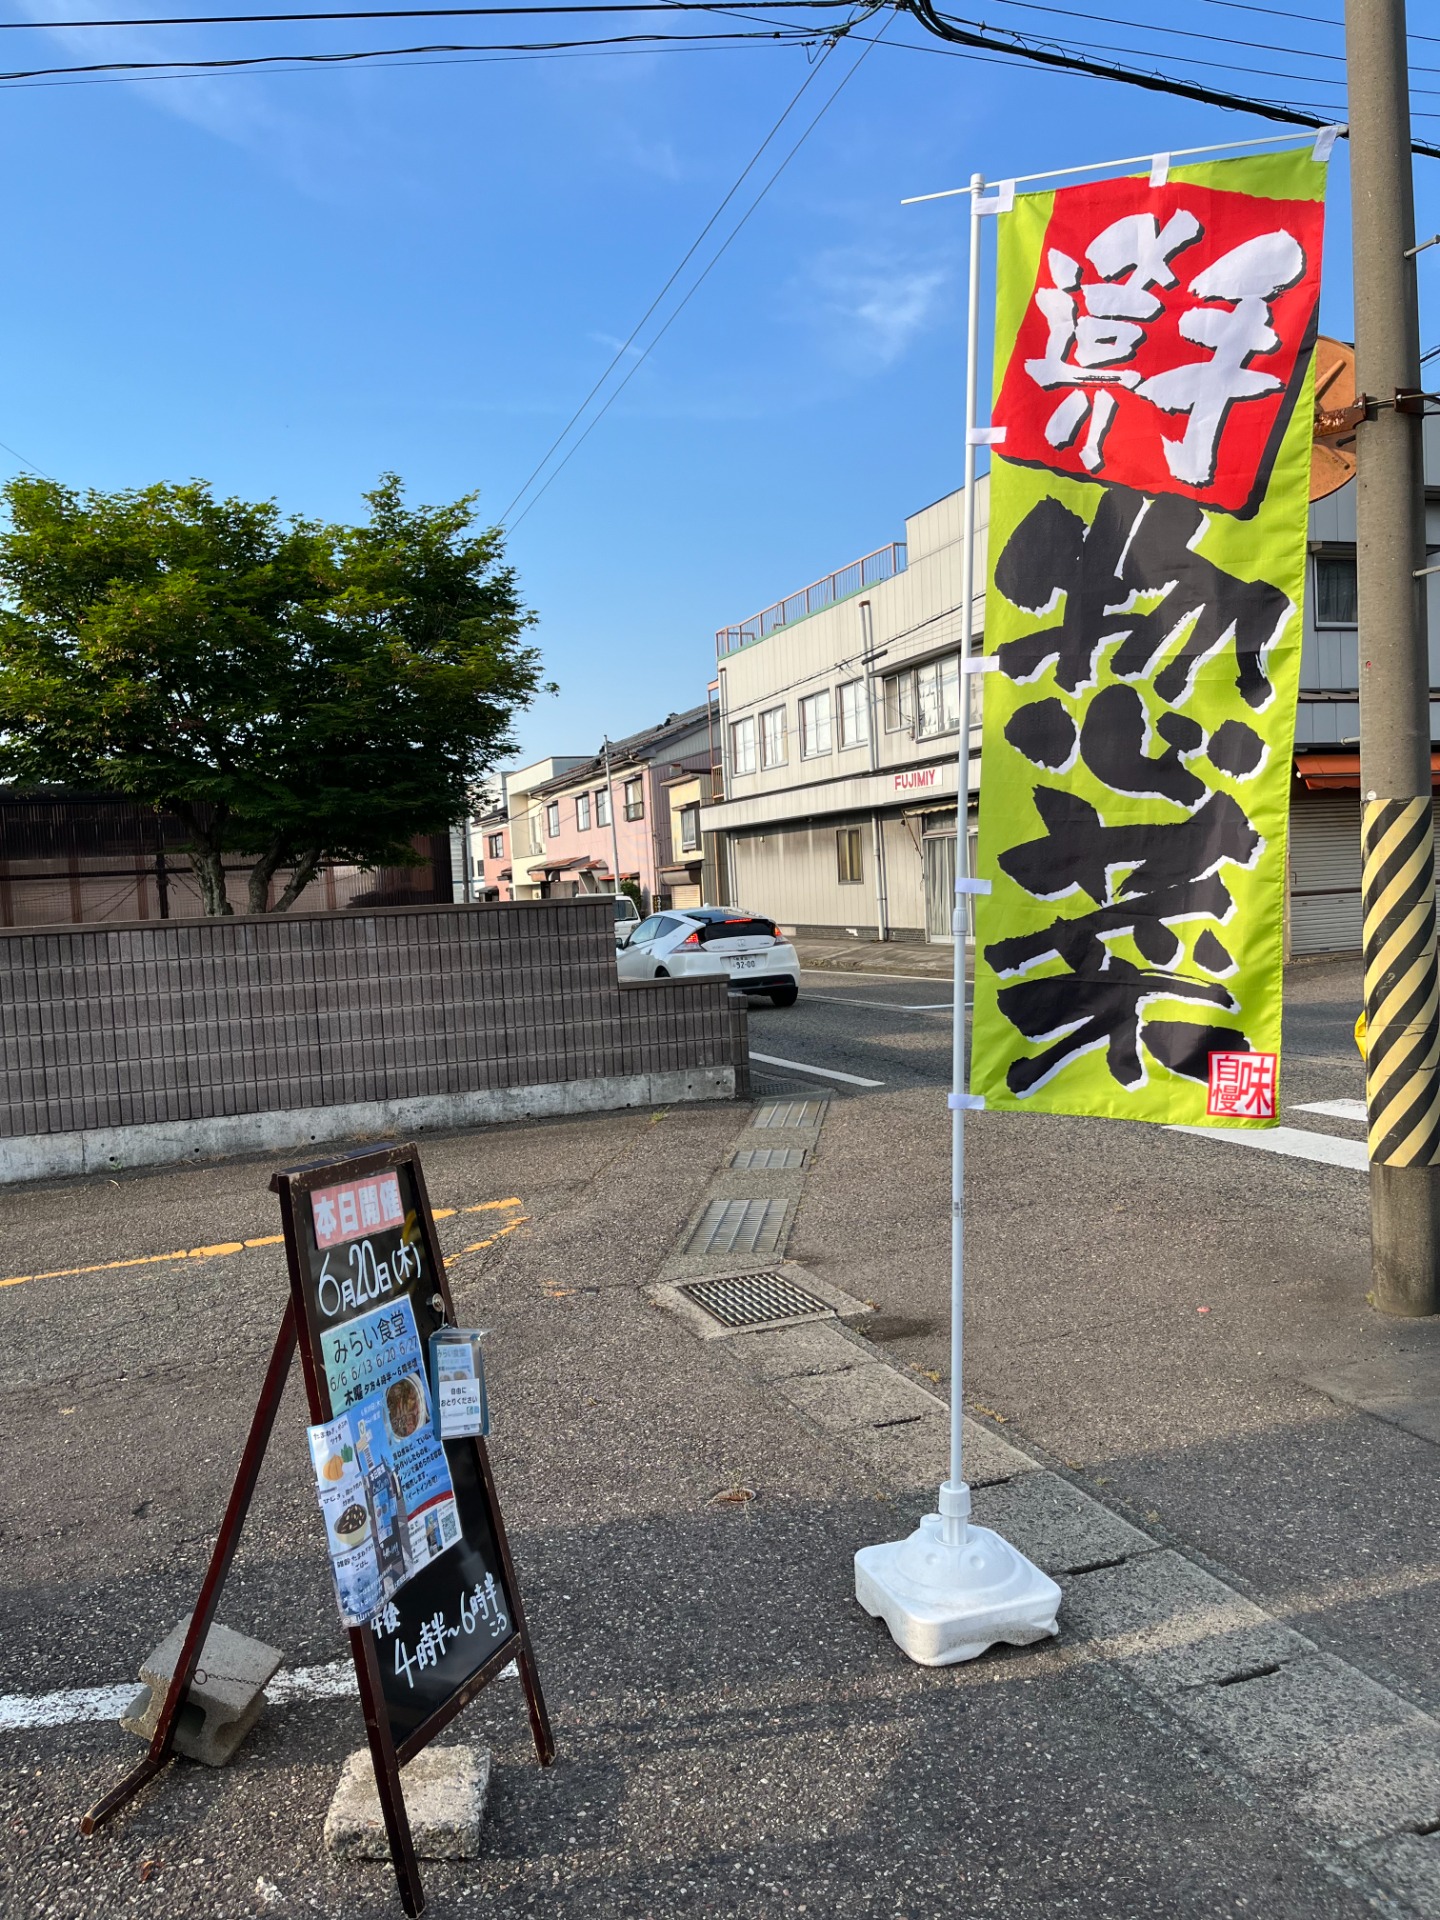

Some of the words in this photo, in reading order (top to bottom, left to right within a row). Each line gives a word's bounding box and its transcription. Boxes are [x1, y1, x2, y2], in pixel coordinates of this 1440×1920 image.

[894, 769, 936, 791] FUJIMIY
[983, 488, 1297, 1099] 惣菜
[313, 1178, 402, 1240] 本日開催
[333, 1312, 408, 1364] みらい食堂
[330, 1371, 348, 1392] 6/6
[351, 1359, 374, 1381] 6/13
[376, 1345, 397, 1367] 6/20
[343, 1383, 364, 1407] 木曜
[440, 1395, 478, 1408] おとりください
[450, 1386, 467, 1395] 自由に
[370, 1600, 400, 1639] 午後
